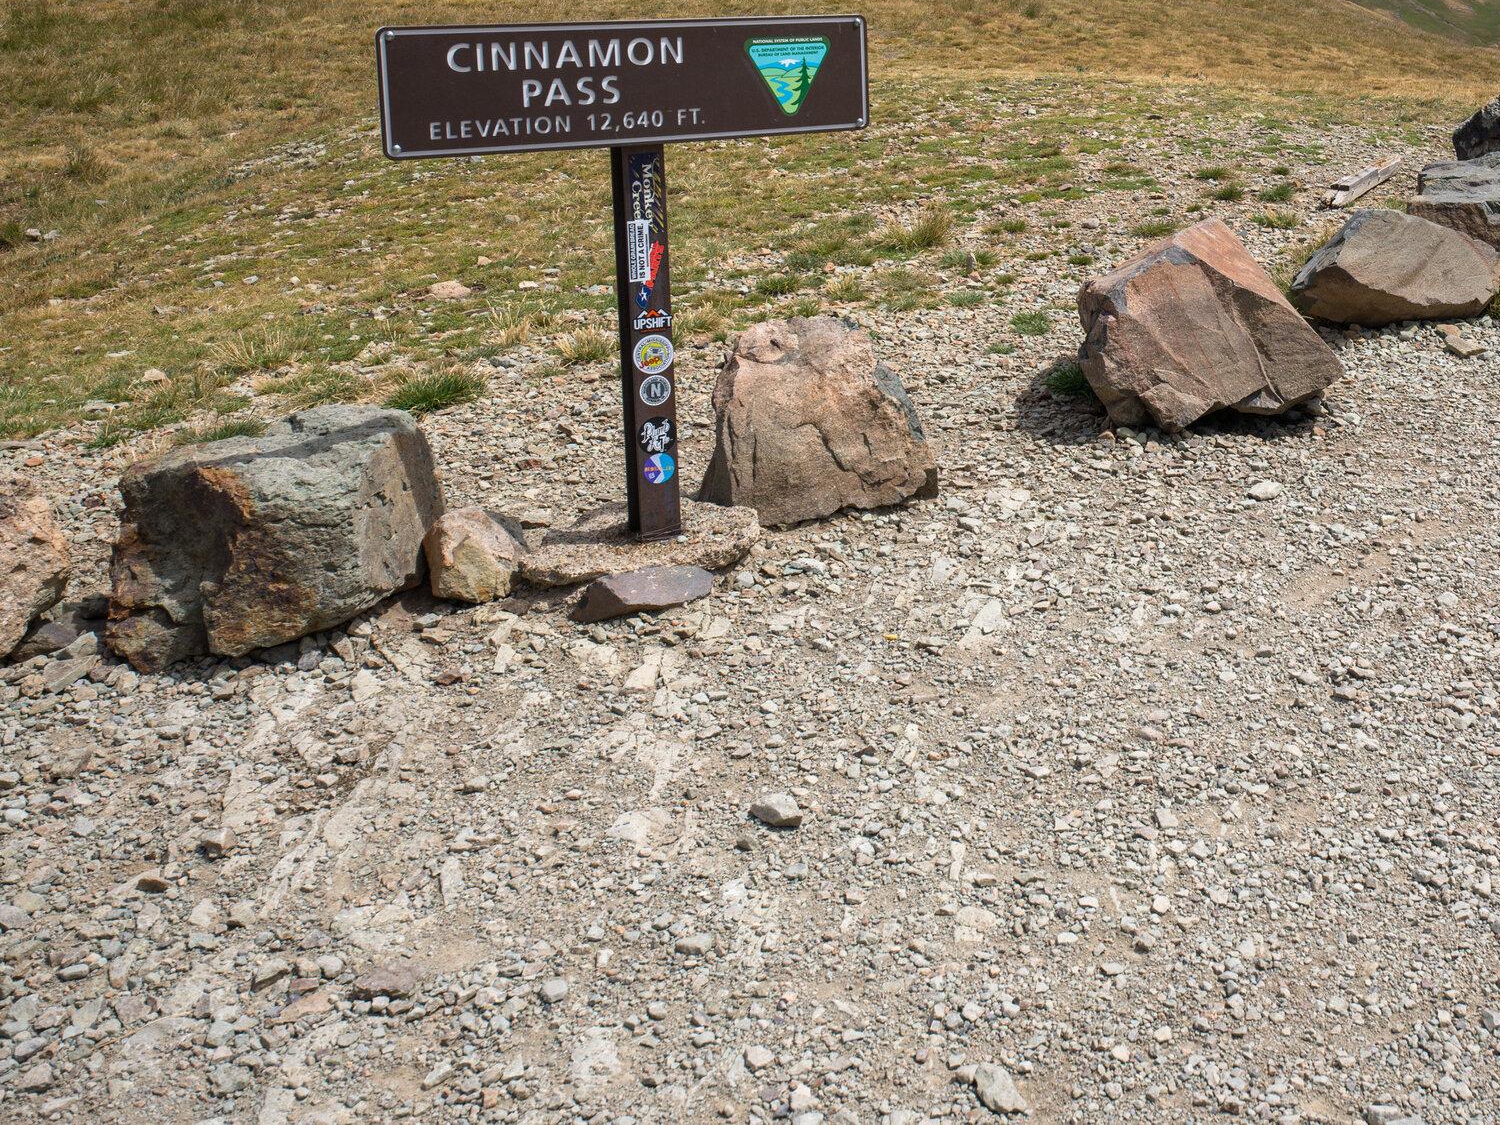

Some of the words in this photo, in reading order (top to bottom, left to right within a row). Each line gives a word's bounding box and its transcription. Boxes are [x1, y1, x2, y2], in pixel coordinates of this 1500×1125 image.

[447, 37, 684, 72] CINNAMON
[523, 75, 621, 108] PASS
[430, 116, 571, 140] ELEVATION
[586, 110, 664, 132] 12,640
[677, 108, 706, 126] FT.
[631, 180, 642, 220] Cree
[641, 163, 655, 227] Monkey
[639, 271, 646, 279] IS
[633, 316, 673, 330] UPSHIFT
[650, 383, 662, 398] N
